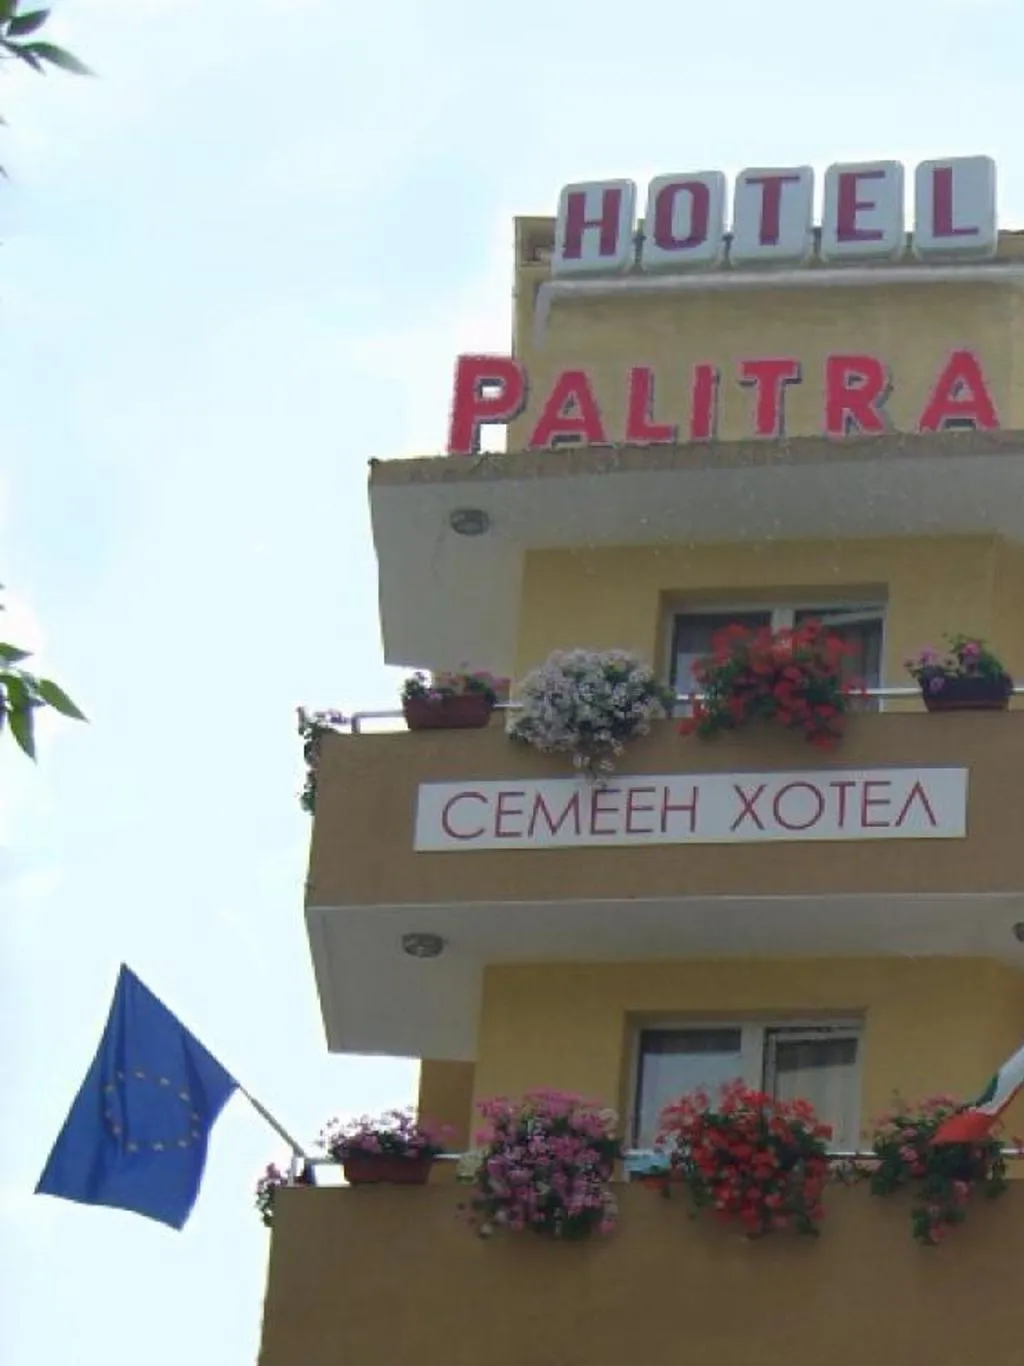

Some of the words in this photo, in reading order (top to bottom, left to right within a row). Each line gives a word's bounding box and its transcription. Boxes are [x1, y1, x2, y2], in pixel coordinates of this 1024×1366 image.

[562, 167, 980, 259] HOTEL
[446, 348, 1001, 456] PALITRA
[441, 785, 698, 840] СЕМЕЕН
[729, 780, 938, 832] ХОТЕЛ
